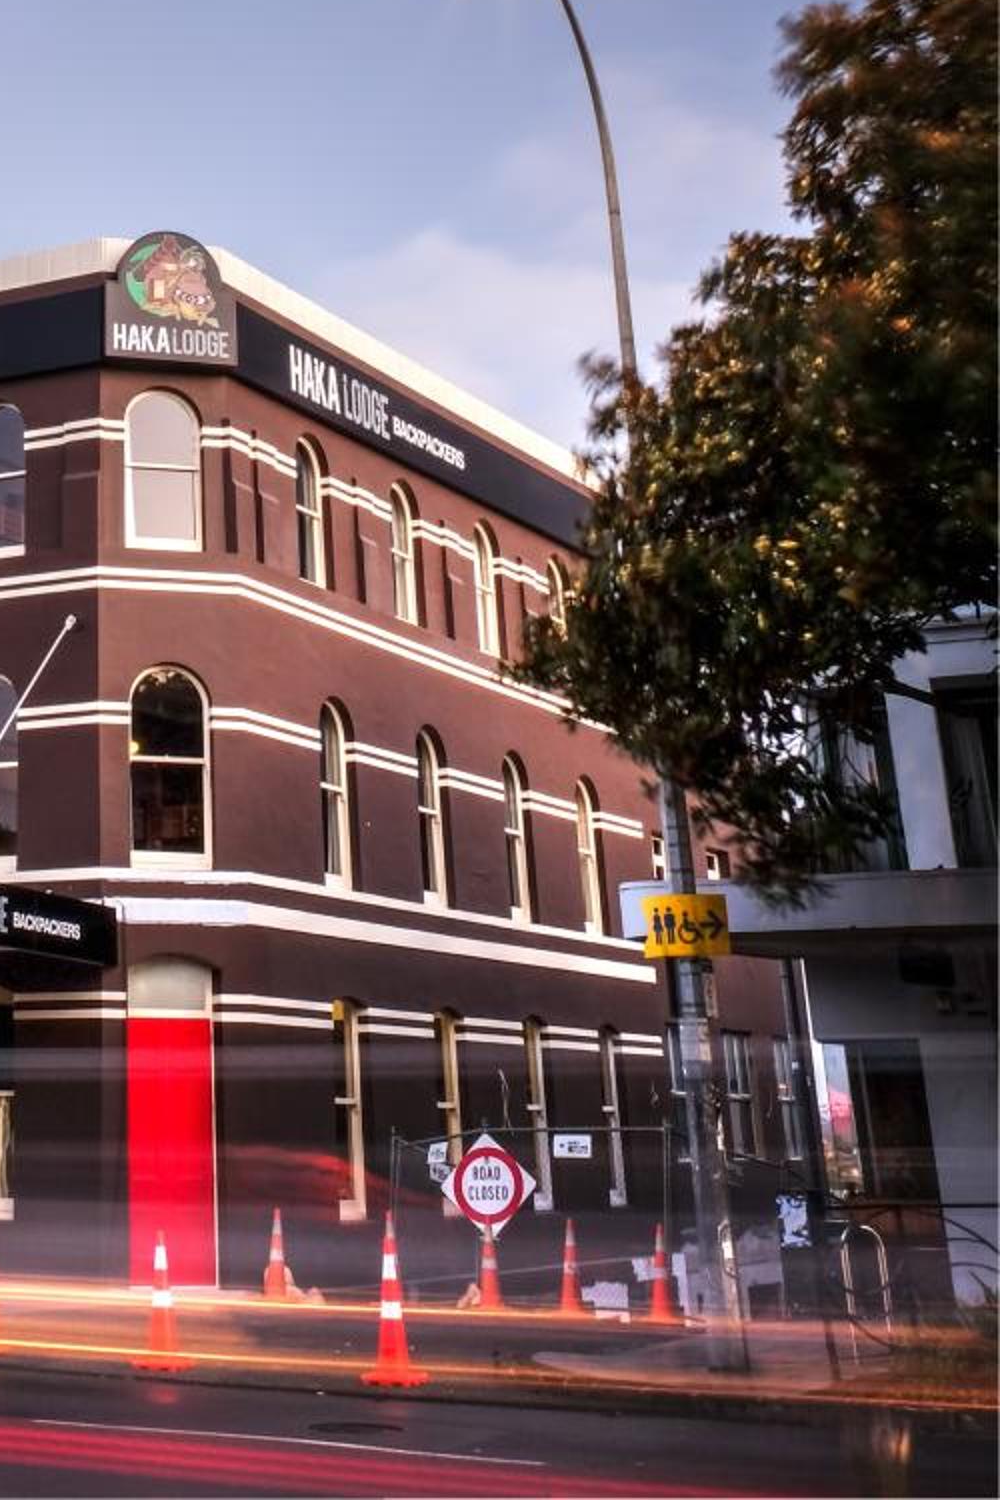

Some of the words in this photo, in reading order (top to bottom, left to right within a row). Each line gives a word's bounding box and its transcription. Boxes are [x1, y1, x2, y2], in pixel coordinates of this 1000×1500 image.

[289, 344, 342, 415] HAKA
[342, 373, 392, 441] LODGE
[391, 415, 466, 472] BACKPACKERS
[12, 911, 81, 941] BACKPACKERS
[473, 1165, 501, 1181] ROAD
[468, 1185, 509, 1201] CLOSED
